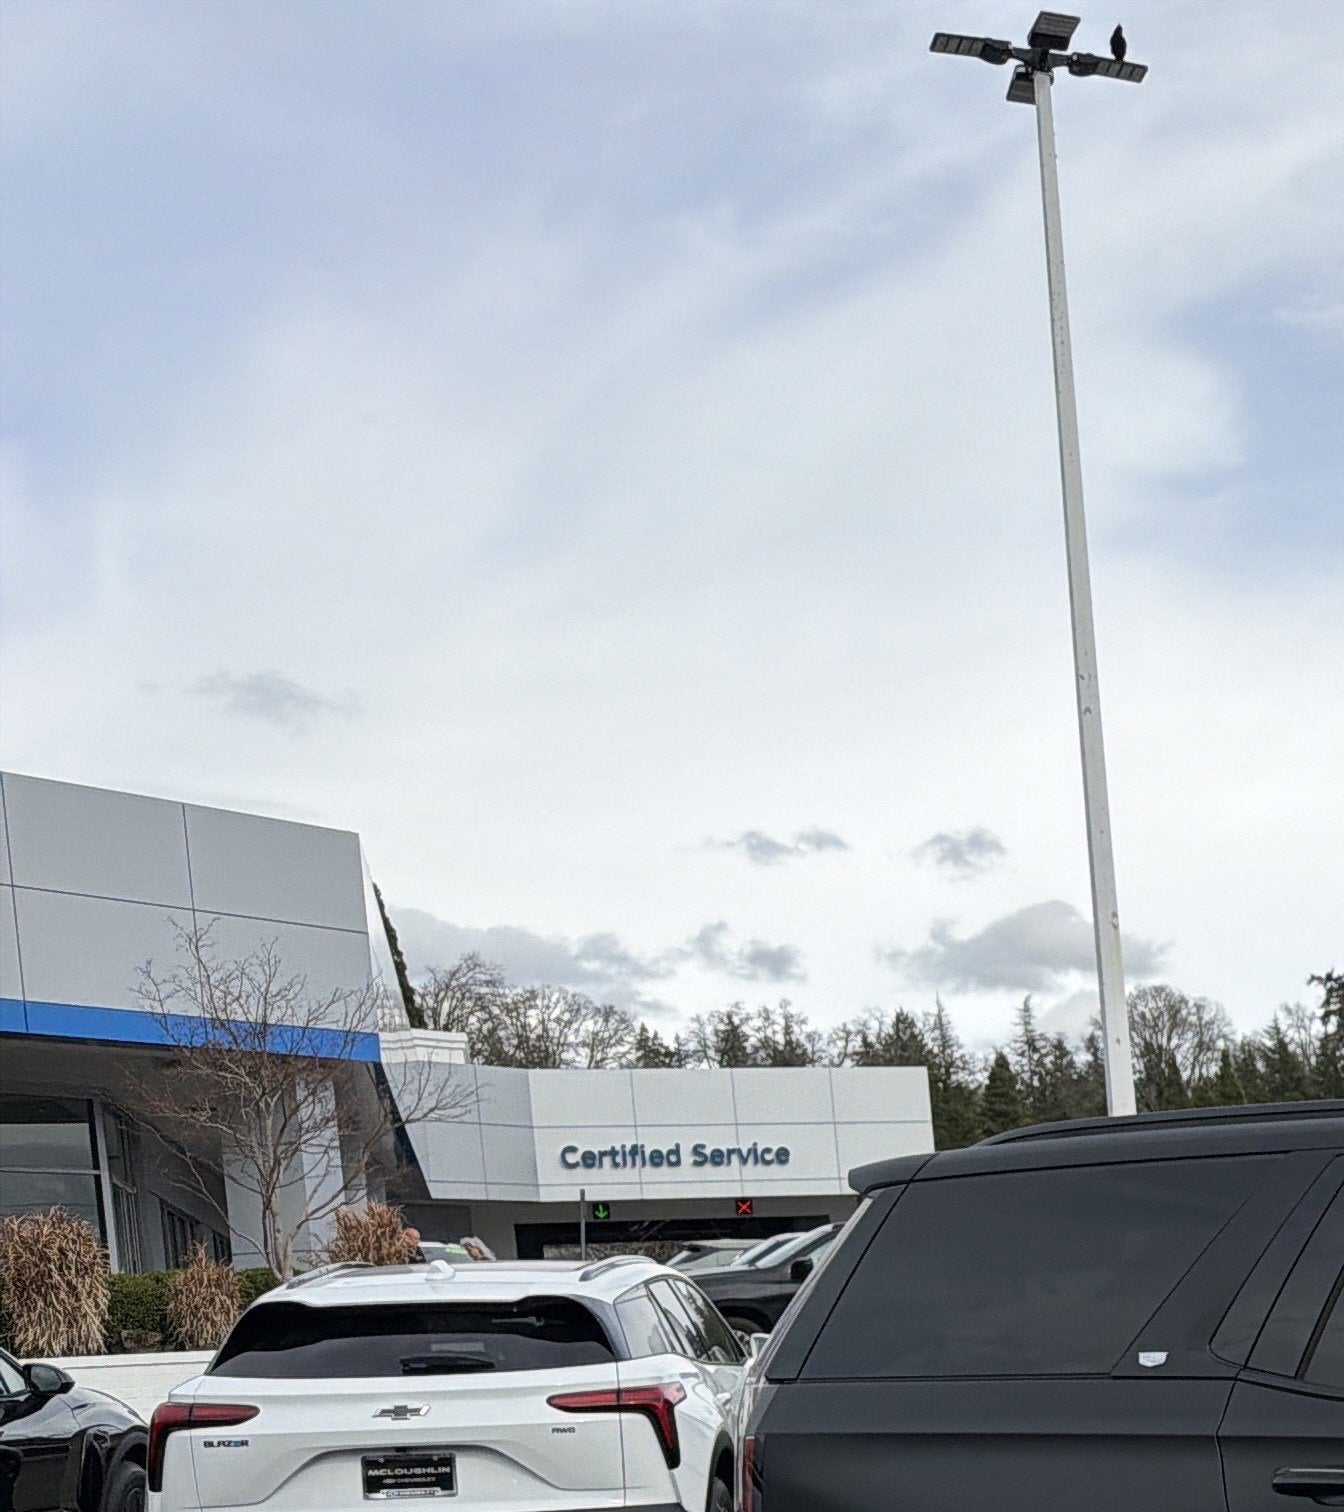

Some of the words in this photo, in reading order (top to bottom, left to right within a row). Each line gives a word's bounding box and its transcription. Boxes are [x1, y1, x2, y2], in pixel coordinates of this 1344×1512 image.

[560, 1142, 682, 1170] Certified
[691, 1141, 791, 1168] Service
[203, 1439, 250, 1449] BLAZER
[367, 1466, 451, 1477] MCLOUGHLIN
